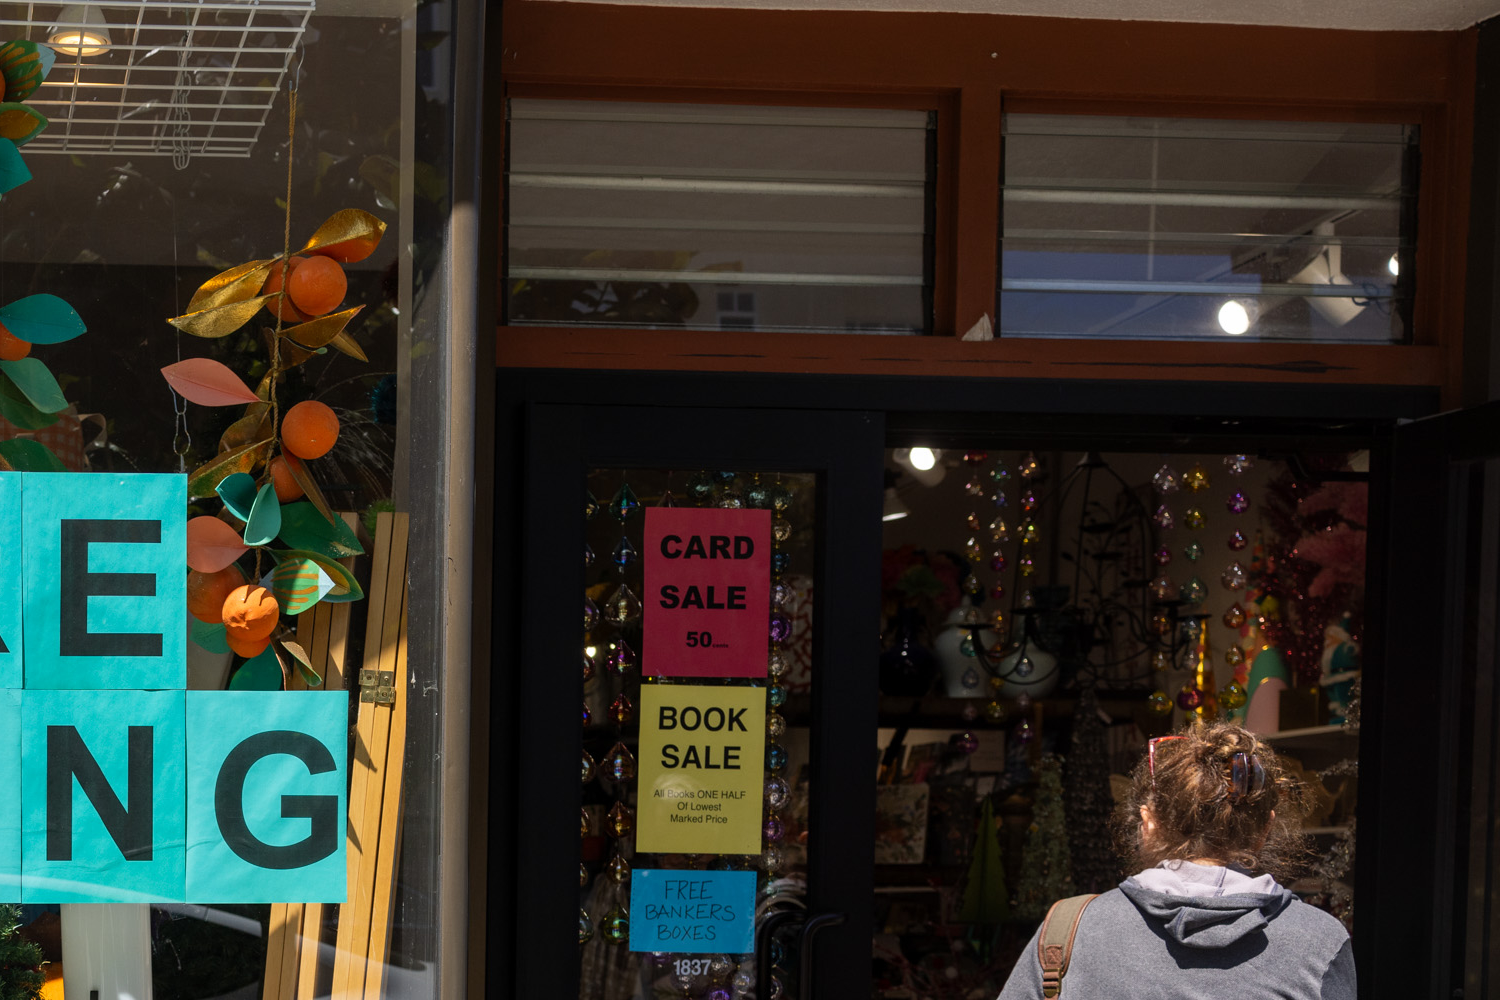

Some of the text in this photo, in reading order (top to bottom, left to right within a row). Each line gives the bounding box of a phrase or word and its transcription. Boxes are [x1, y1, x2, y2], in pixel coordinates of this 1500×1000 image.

[661, 535, 754, 559] CARD
[660, 585, 746, 609] SALE
[686, 632, 712, 648] 50
[659, 706, 747, 731] BOOK
[661, 744, 740, 769] SALE
[654, 789, 746, 800] All Books ONE HALF
[677, 802, 721, 811] Of Lowest
[671, 814, 727, 823] Marked Price
[665, 880, 713, 900] FREE
[645, 904, 736, 921] BANKERS
[657, 924, 716, 941] BOXES
[673, 959, 712, 976] 1837
